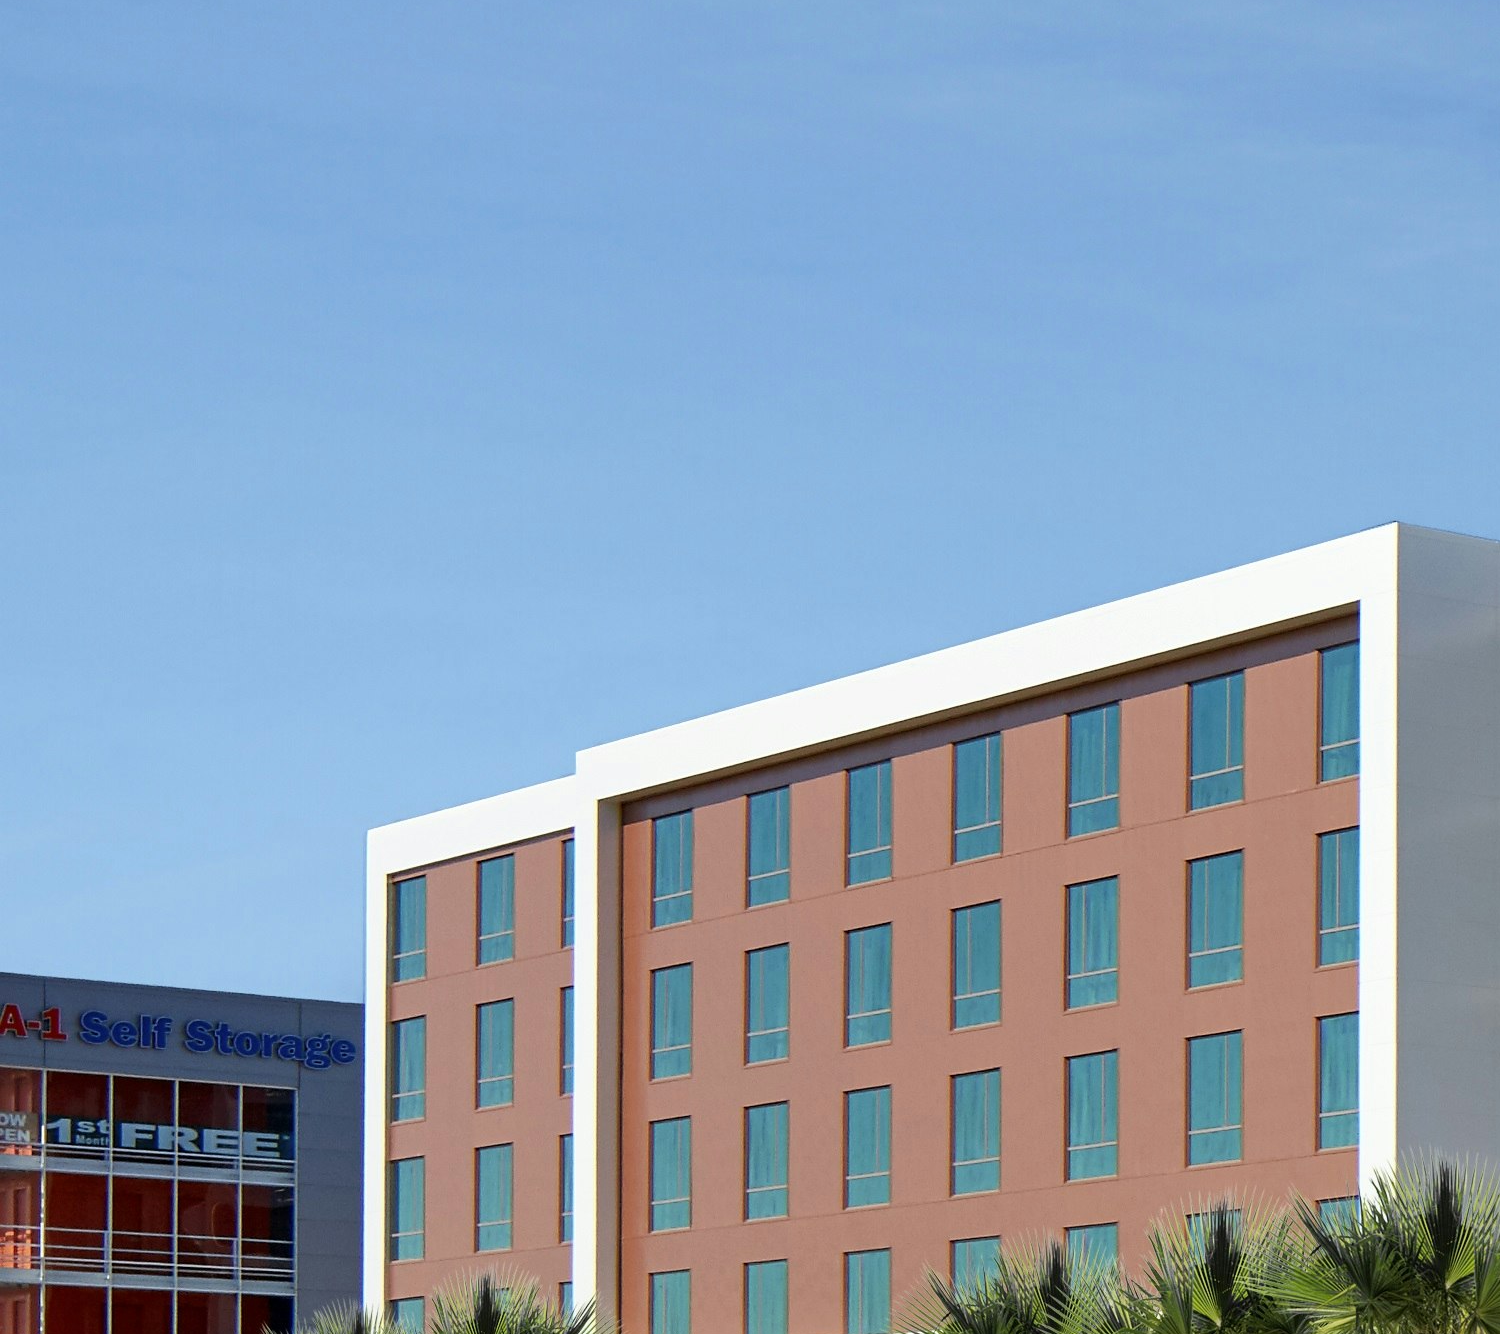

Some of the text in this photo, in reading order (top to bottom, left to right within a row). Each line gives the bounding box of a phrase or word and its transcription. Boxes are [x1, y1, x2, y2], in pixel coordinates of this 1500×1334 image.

[0, 1003, 356, 1070] A-1 Self Storage
[0, 1113, 27, 1127] OW
